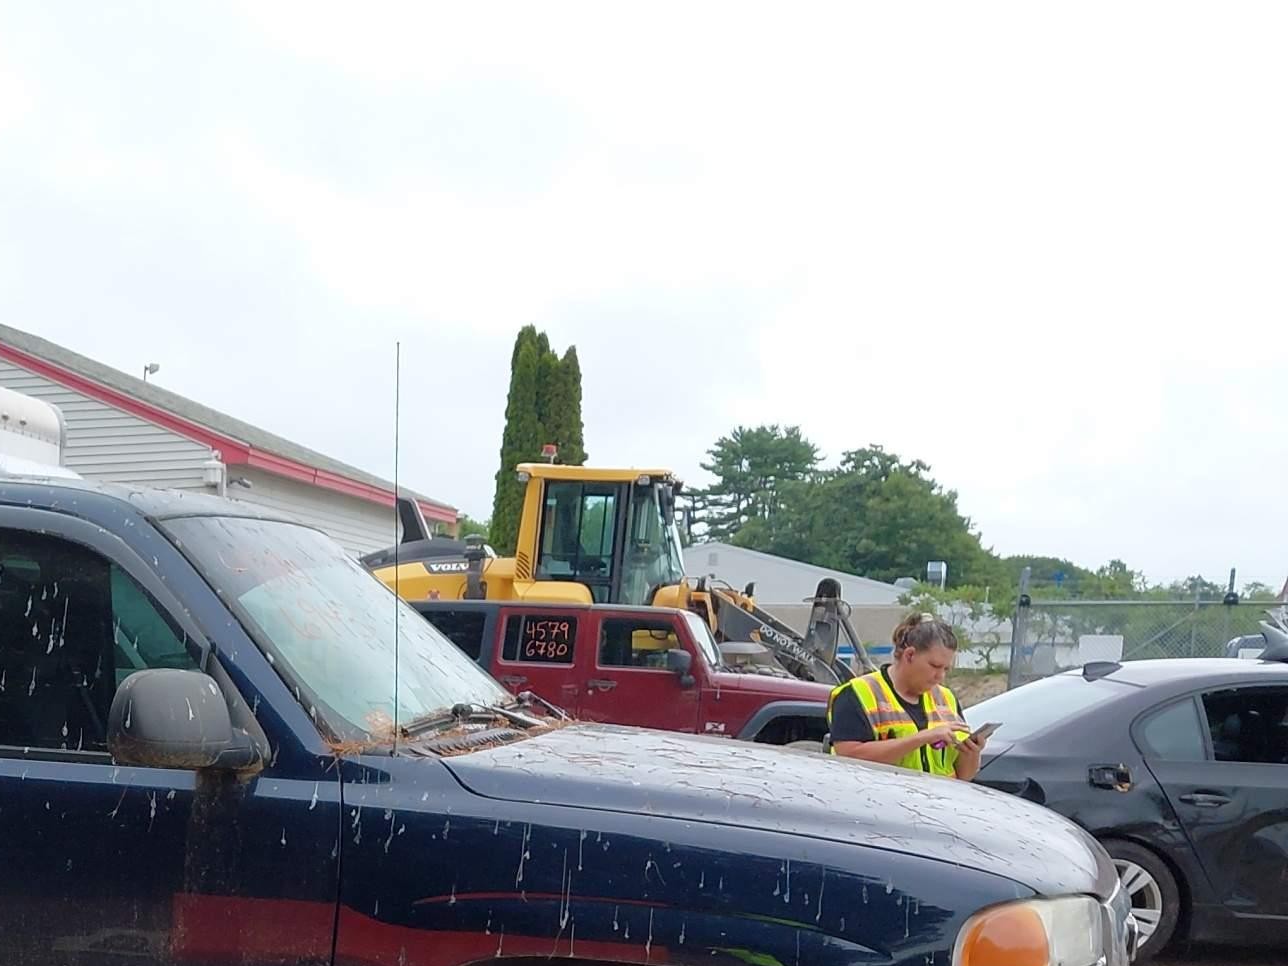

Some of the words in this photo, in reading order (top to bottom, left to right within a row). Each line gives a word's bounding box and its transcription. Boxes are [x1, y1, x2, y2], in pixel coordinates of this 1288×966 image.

[430, 562, 470, 572] VOLV
[526, 620, 569, 640] 4579
[525, 640, 568, 658] 6780
[760, 624, 773, 638] DO
[773, 634, 792, 648] NOT
[792, 645, 816, 664] WALK
